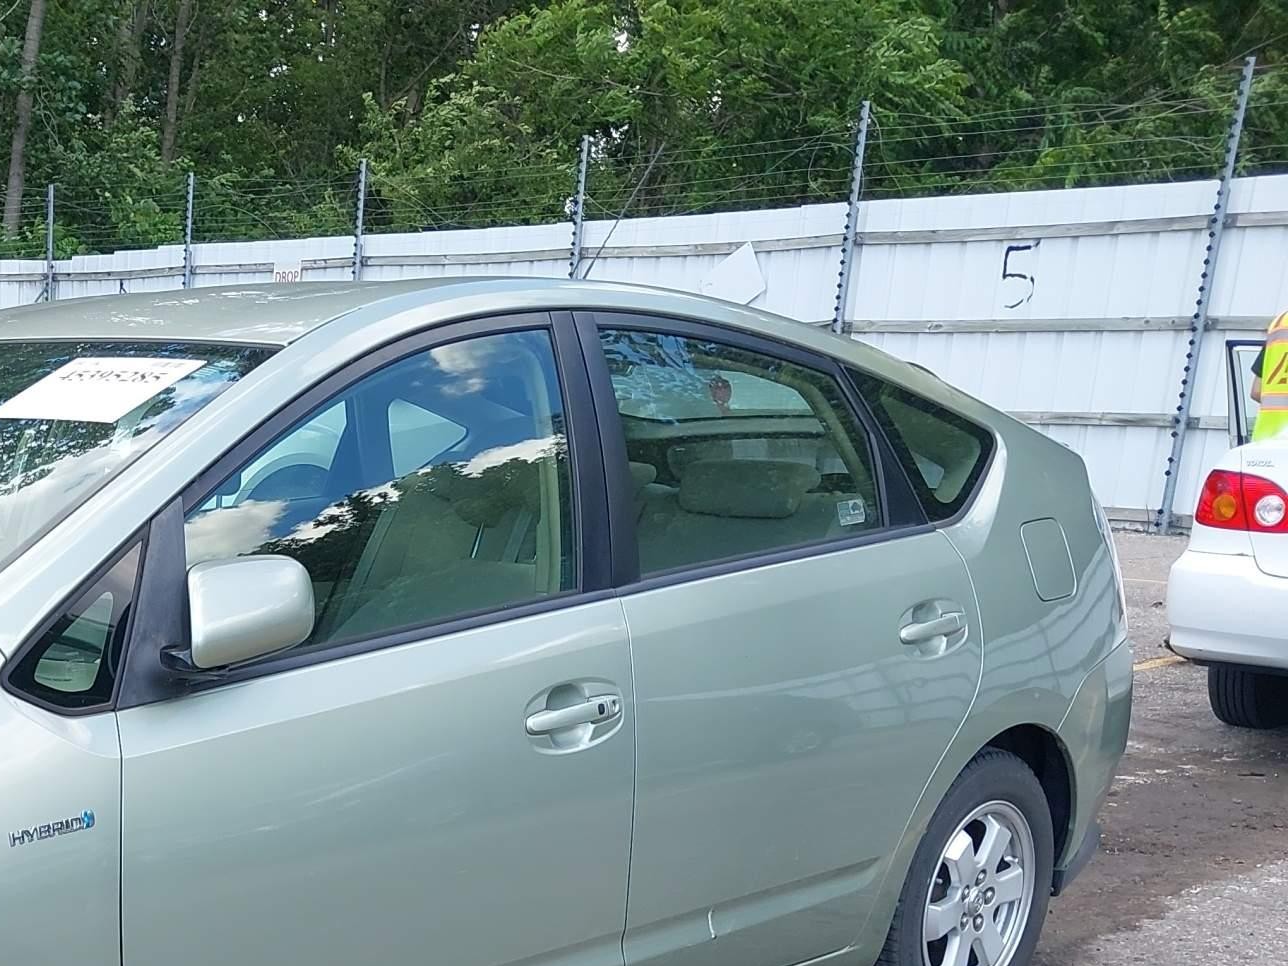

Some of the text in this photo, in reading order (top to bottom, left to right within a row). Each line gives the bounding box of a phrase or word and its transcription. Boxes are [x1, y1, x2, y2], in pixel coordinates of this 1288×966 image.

[275, 270, 299, 283] DROP
[1002, 239, 1040, 309] 5
[8, 817, 83, 848] HYBRID
